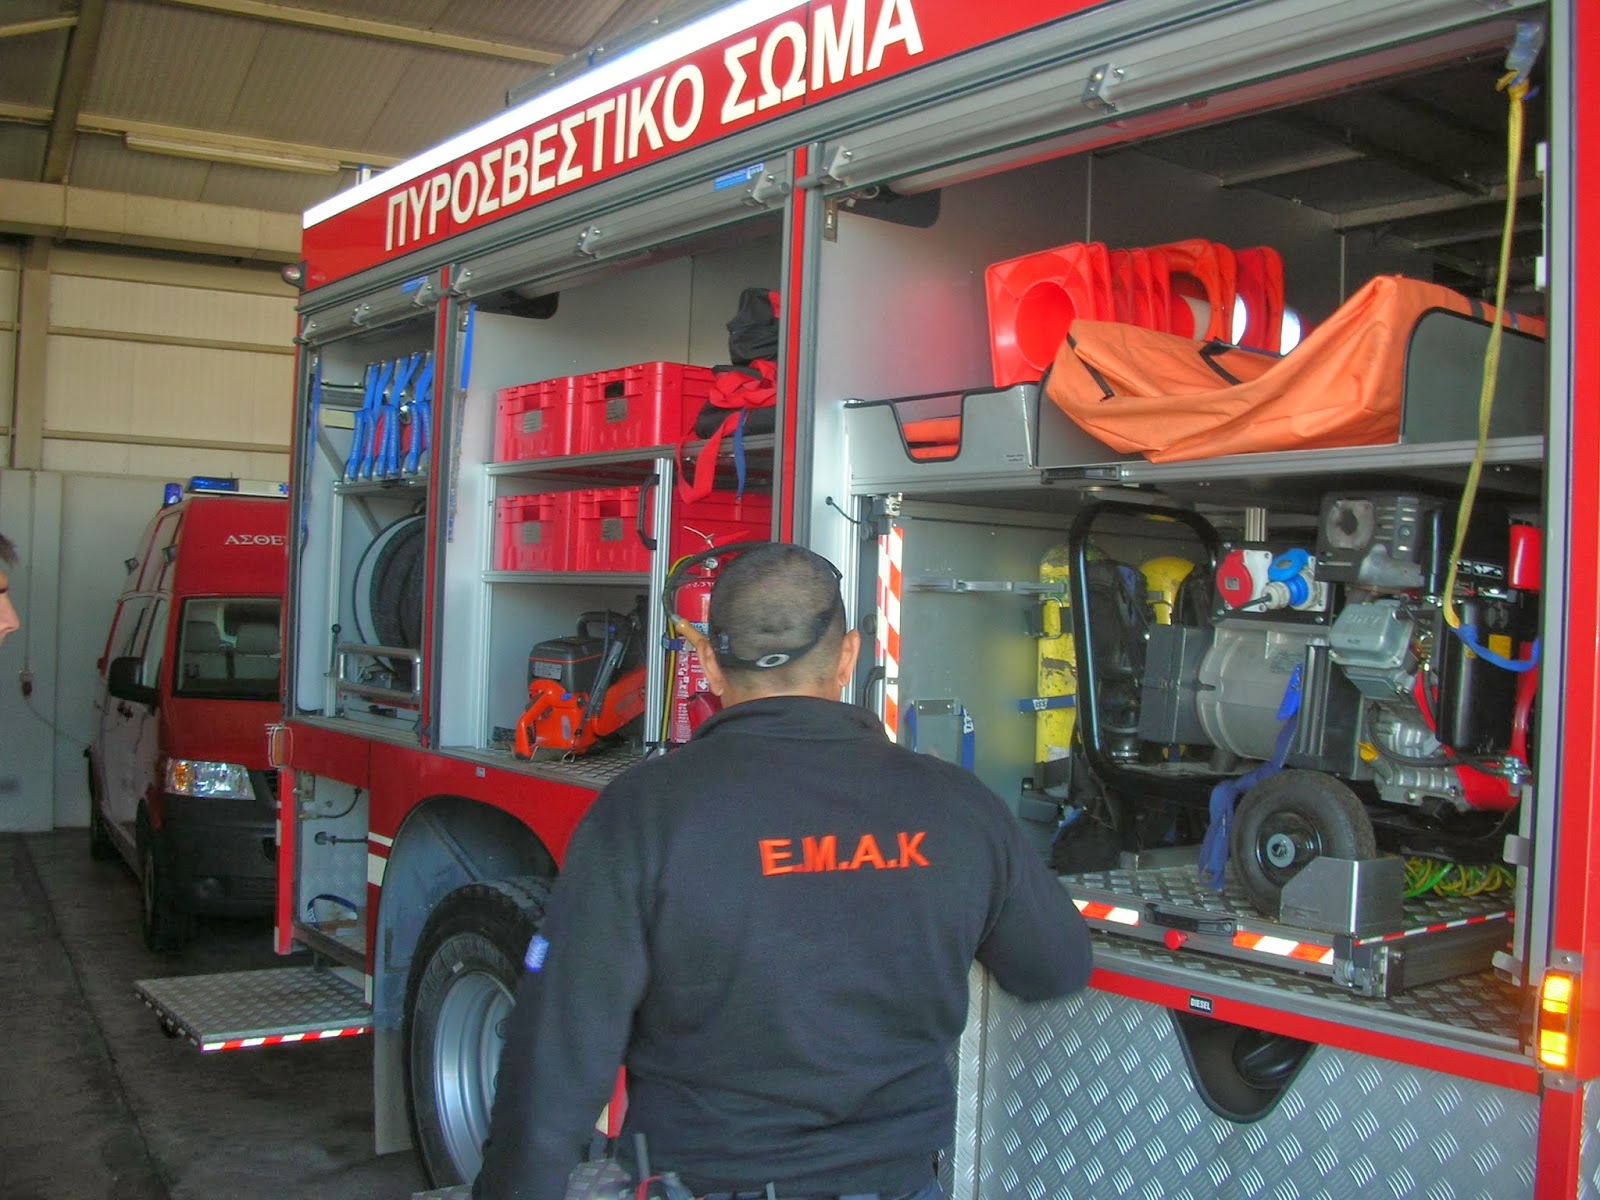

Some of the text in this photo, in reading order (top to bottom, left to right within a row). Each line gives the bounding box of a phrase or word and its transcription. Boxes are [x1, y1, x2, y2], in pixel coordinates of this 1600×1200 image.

[385, 0, 924, 252] ΠΥΡΟΣΒΕΣΤΙΚΟ ΣΩΜΑ
[224, 534, 287, 546] ΑΣΘΕ
[1190, 997, 1211, 1011] DIESEL
